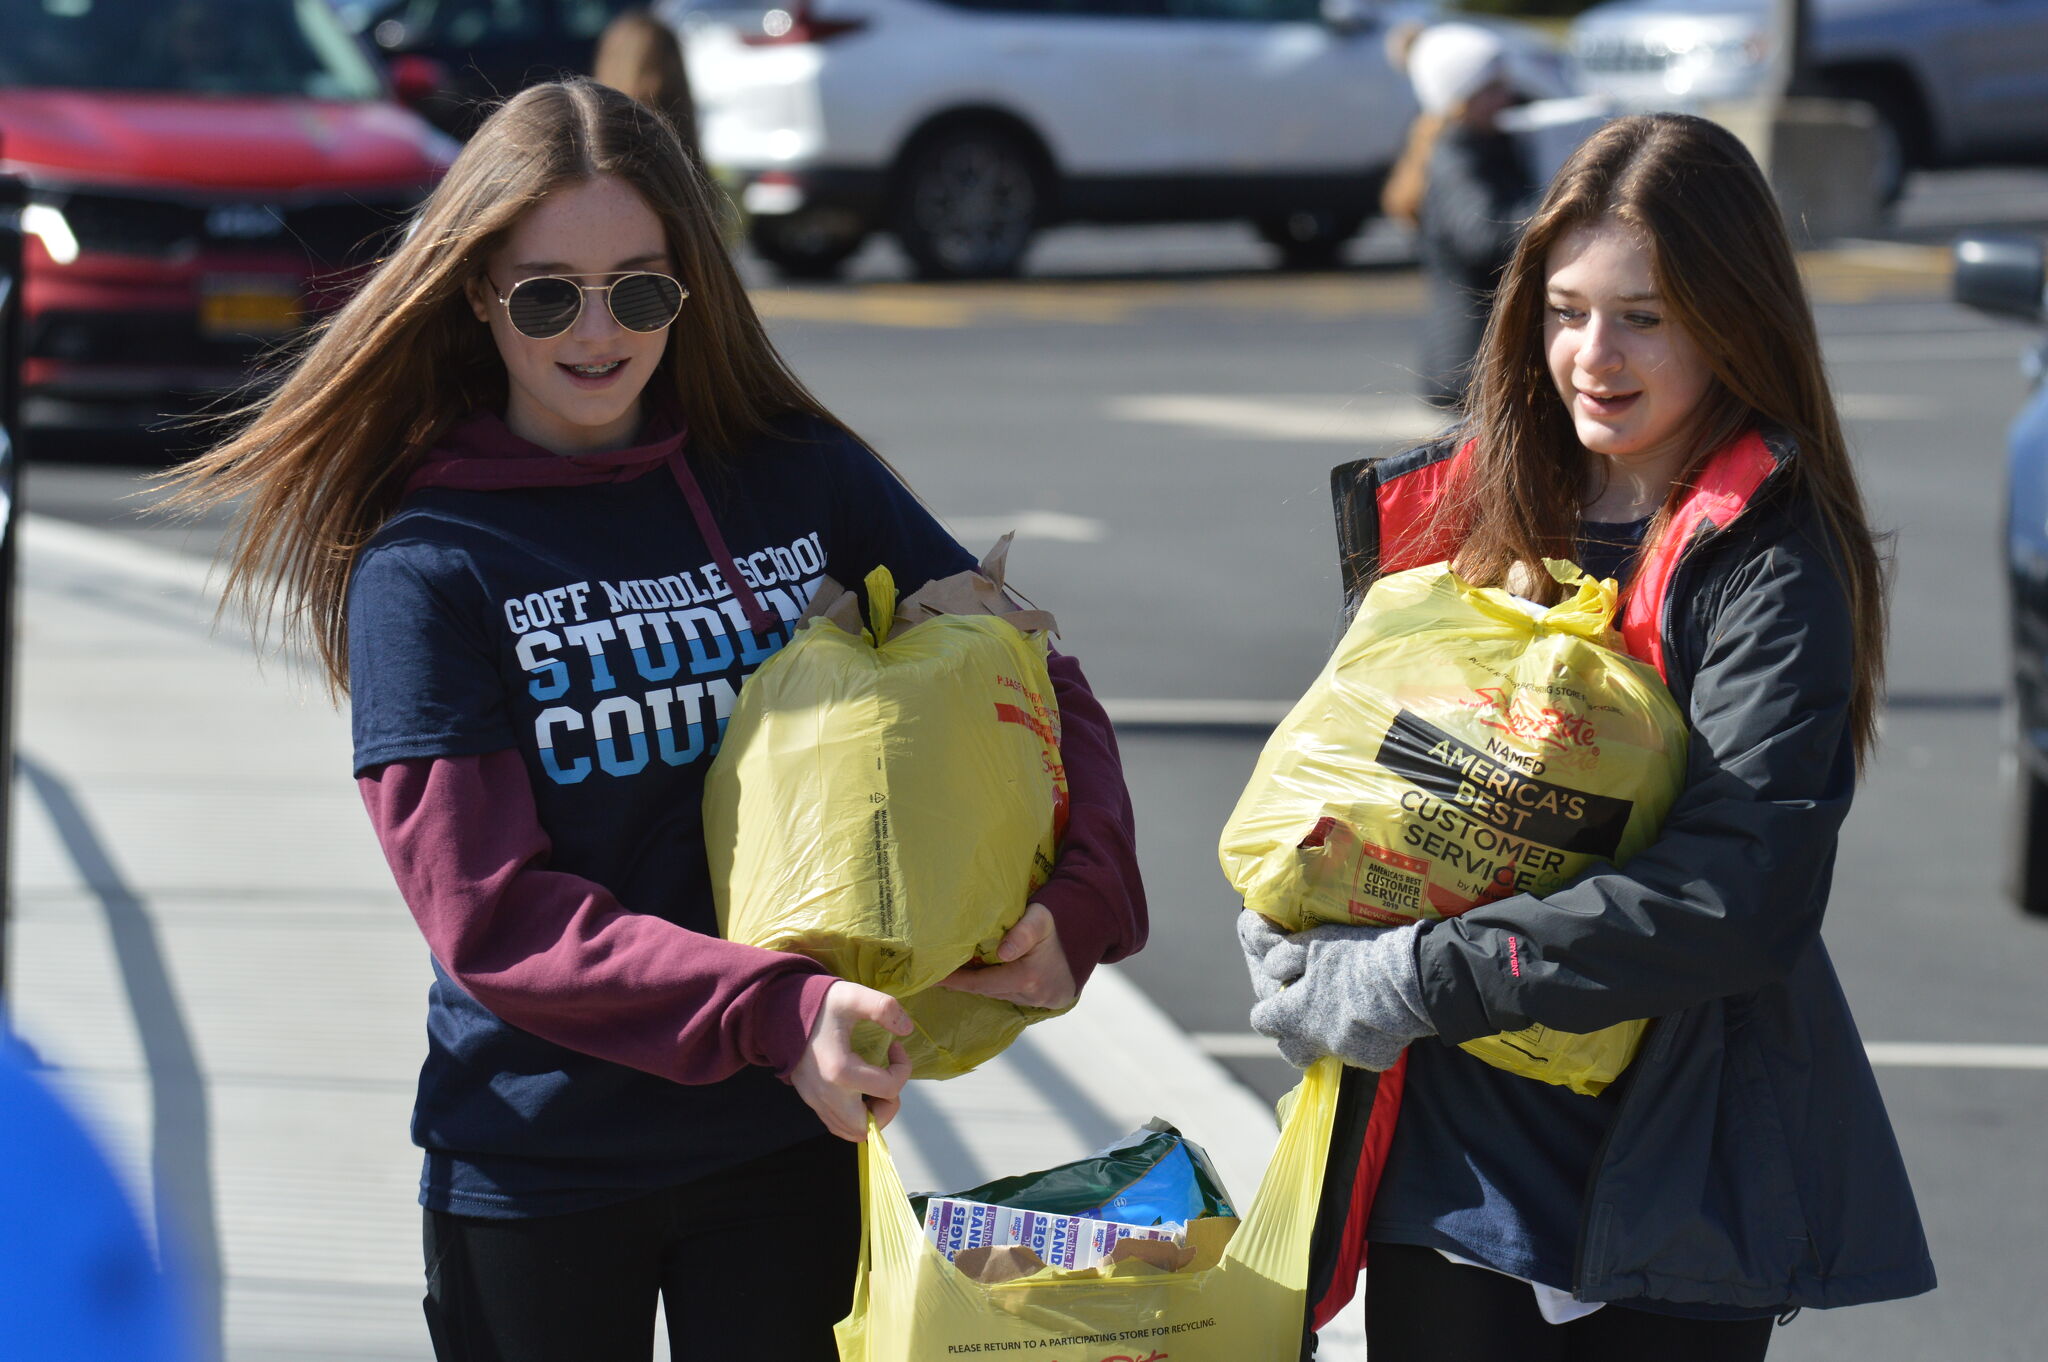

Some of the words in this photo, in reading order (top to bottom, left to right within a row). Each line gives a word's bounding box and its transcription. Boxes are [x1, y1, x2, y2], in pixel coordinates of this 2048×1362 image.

[504, 581, 590, 634] GOFF
[600, 562, 733, 613] MIDDLE
[733, 531, 827, 588] SCHOOL
[515, 574, 825, 701] STUDEN
[535, 673, 753, 785] COUN
[1486, 737, 1546, 775] NAMED
[1428, 739, 1586, 820] AMERICA'S
[1454, 780, 1532, 831] BEST
[1400, 790, 1566, 873] CUSTOMER
[1368, 863, 1404, 881] AMERICA'S
[1406, 875, 1422, 886] BEST
[1403, 824, 1536, 891] SERVICE
[1364, 883, 1419, 909] SERVICE
[1367, 872, 1420, 897] CUSTOMER
[1382, 900, 1399, 910] 2019
[1509, 936, 1520, 977] DRYVENT
[939, 1226, 949, 1256] abric
[1051, 1218, 1068, 1265] BAND
[948, 1343, 982, 1354] PLEASE
[984, 1341, 1021, 1351] RETURN
[1023, 1340, 1037, 1349] TO
[1039, 1339, 1048, 1348] A
[1049, 1332, 1117, 1346] PARTICIPATING
[1119, 1329, 1149, 1340] STORE
[1151, 1326, 1170, 1336] FOR
[1171, 1318, 1217, 1333] RECYCLING.
